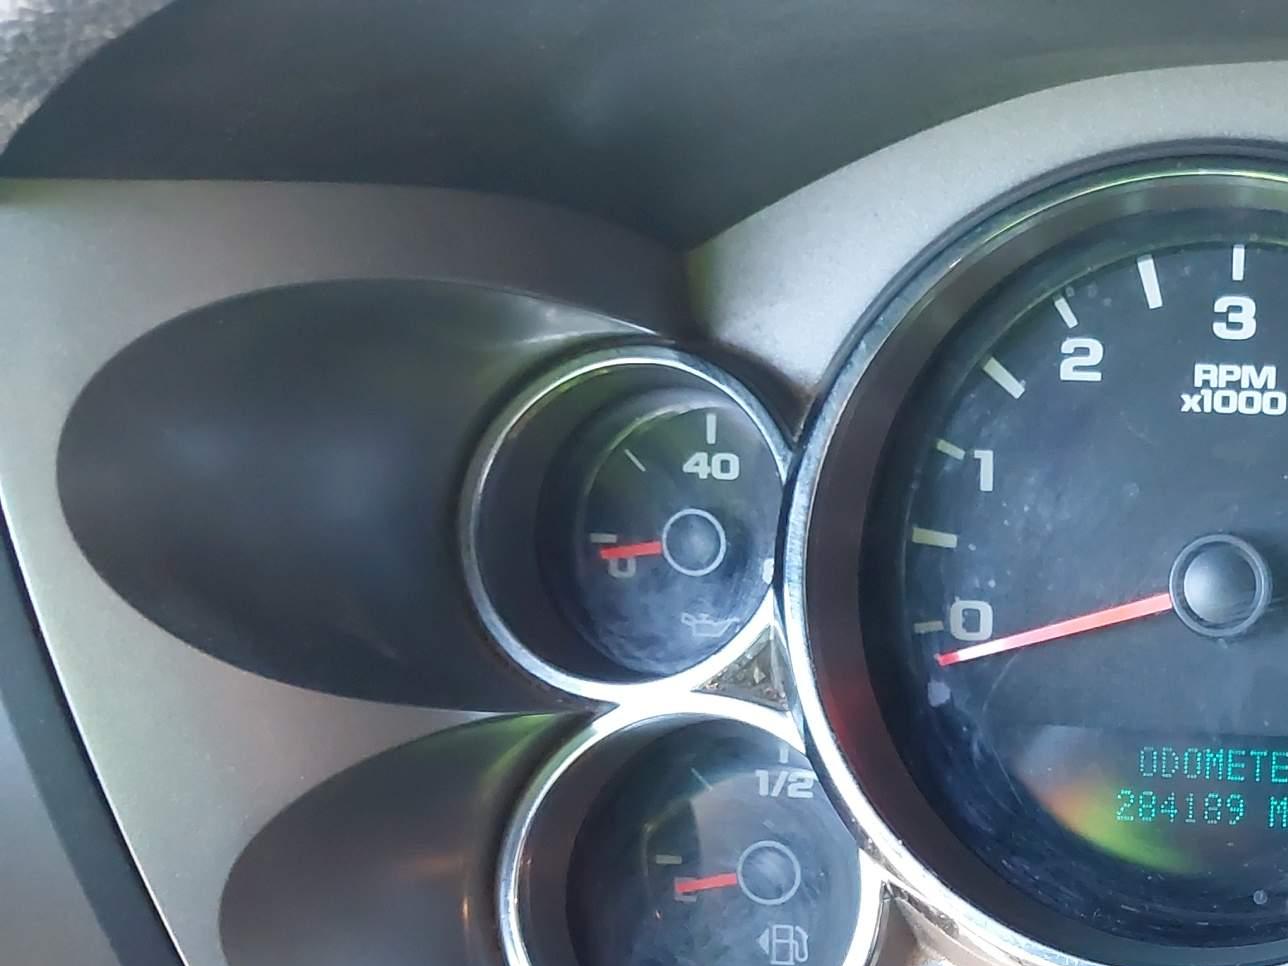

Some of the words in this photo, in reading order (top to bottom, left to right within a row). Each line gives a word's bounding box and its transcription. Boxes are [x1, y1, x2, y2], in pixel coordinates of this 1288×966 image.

[1213, 296, 1255, 340] 3
[1059, 338, 1103, 381] 2
[1194, 364, 1275, 389] RPM
[1181, 390, 1287, 415] x1000
[683, 452, 740, 480] 40
[973, 449, 993, 491] 1
[950, 600, 993, 641] 0
[755, 770, 819, 799] 1/2
